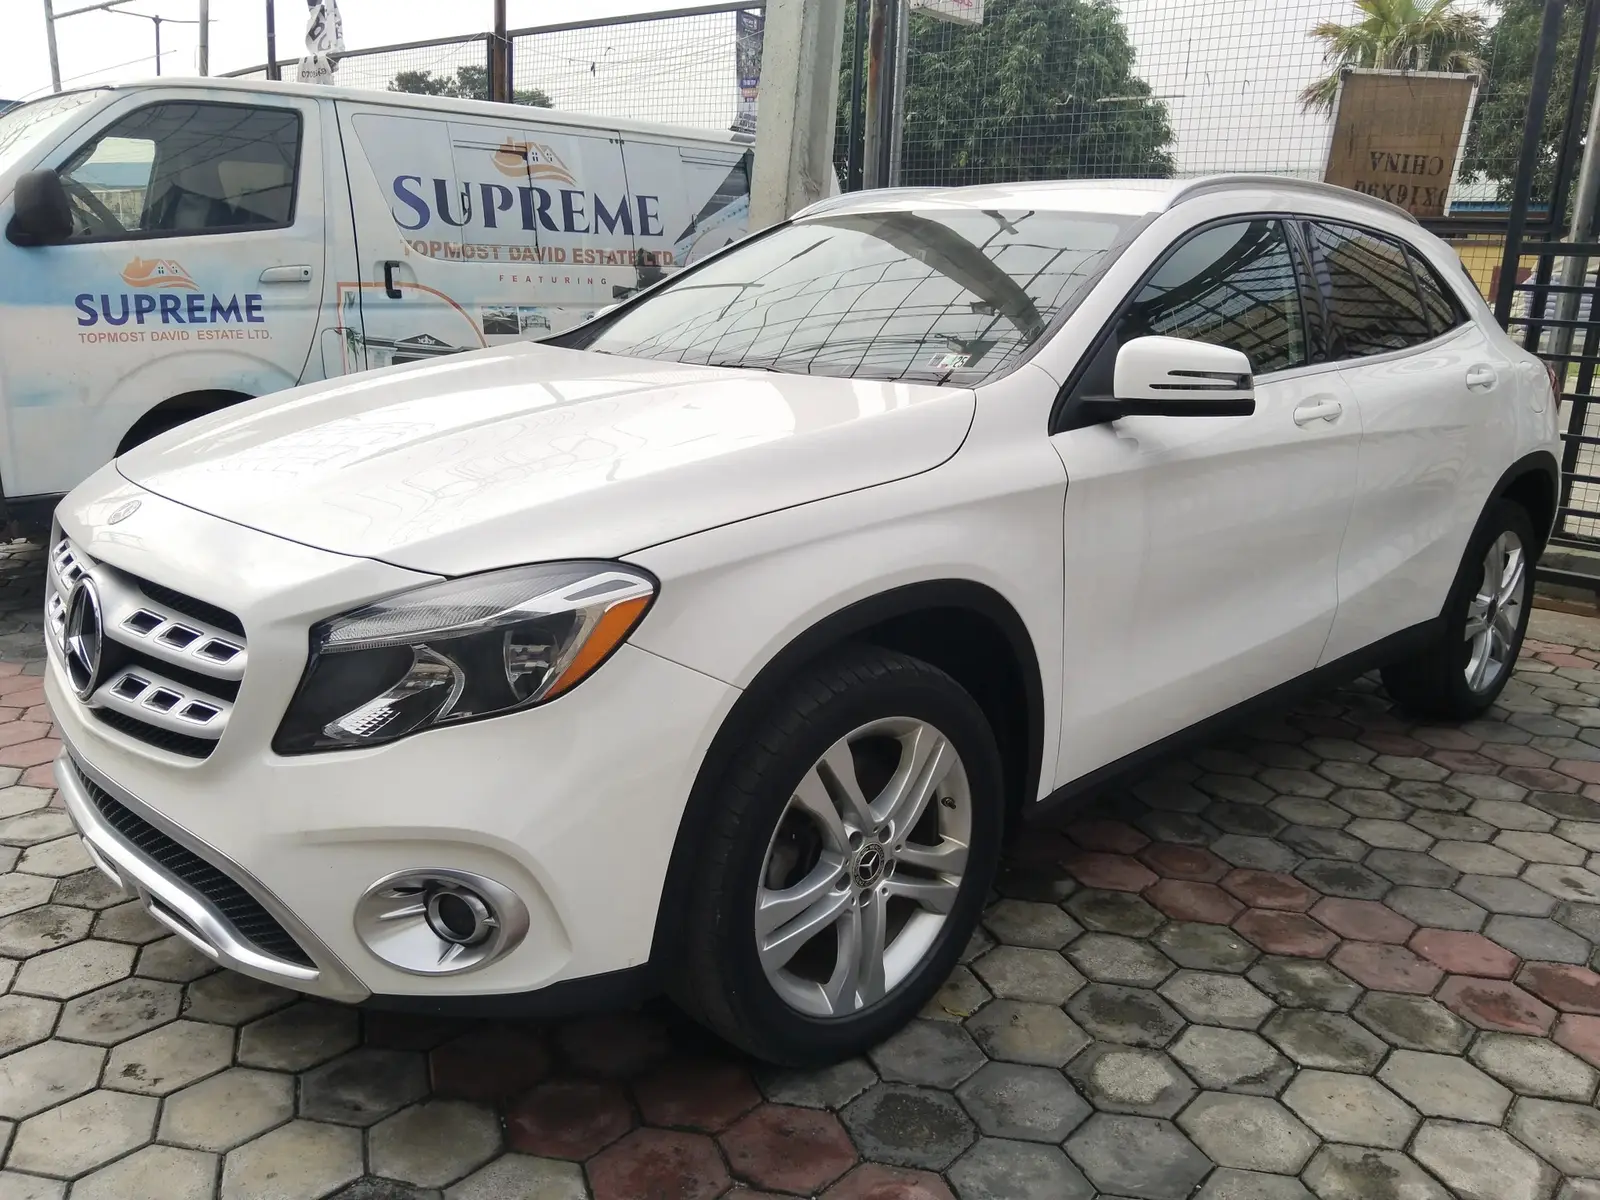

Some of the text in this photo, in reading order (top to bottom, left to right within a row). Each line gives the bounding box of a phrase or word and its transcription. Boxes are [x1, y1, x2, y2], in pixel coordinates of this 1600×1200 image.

[1370, 151, 1443, 177] CHINA
[392, 175, 664, 237] SUPREME
[400, 239, 502, 260] TOPMOST
[508, 246, 567, 264] DAVID
[572, 248, 638, 265] ESTATE
[499, 274, 607, 285] FEATURING
[74, 293, 265, 327] SUPREME
[78, 329, 273, 344] TOPMOST DAVID ESTATE LTD.
